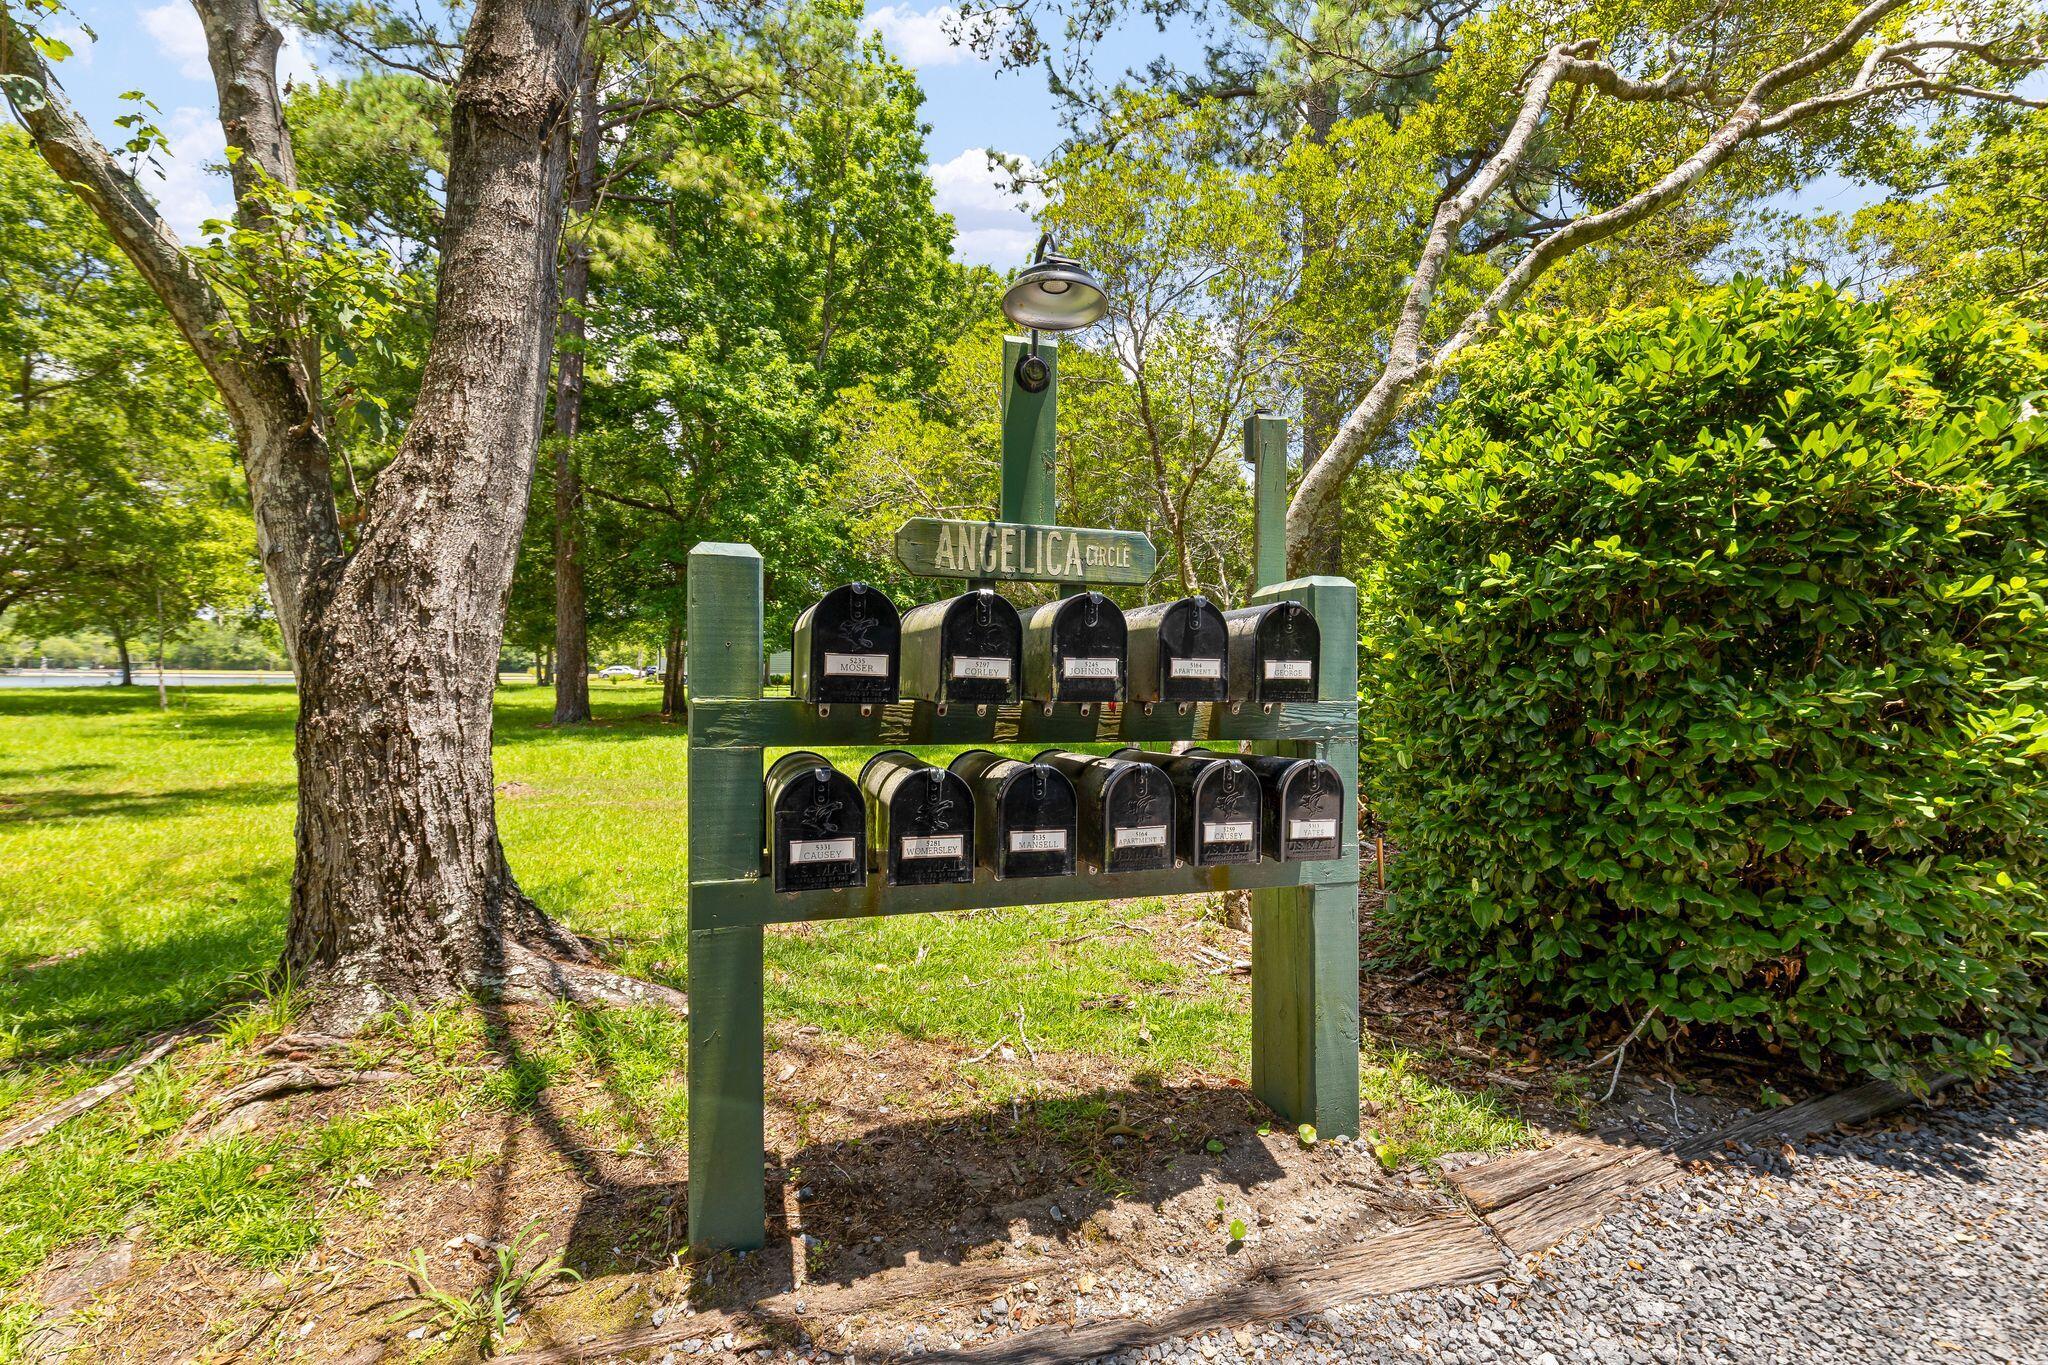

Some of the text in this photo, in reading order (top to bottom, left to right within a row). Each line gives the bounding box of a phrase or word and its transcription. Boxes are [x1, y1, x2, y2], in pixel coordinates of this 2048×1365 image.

[934, 524, 1130, 577] ANGELICA CIRCLE
[840, 664, 874, 672] MOSER
[964, 668, 999, 676] CORLEY
[1070, 667, 1113, 675] JOHNSON
[1214, 832, 1243, 840] CAUSEY
[1303, 829, 1325, 837] YATES
[1019, 841, 1059, 849] MANSELL
[1118, 837, 1157, 845] APARTMENT
[803, 850, 842, 860] CAUSEY
[906, 846, 958, 856] WOMERSLEY
